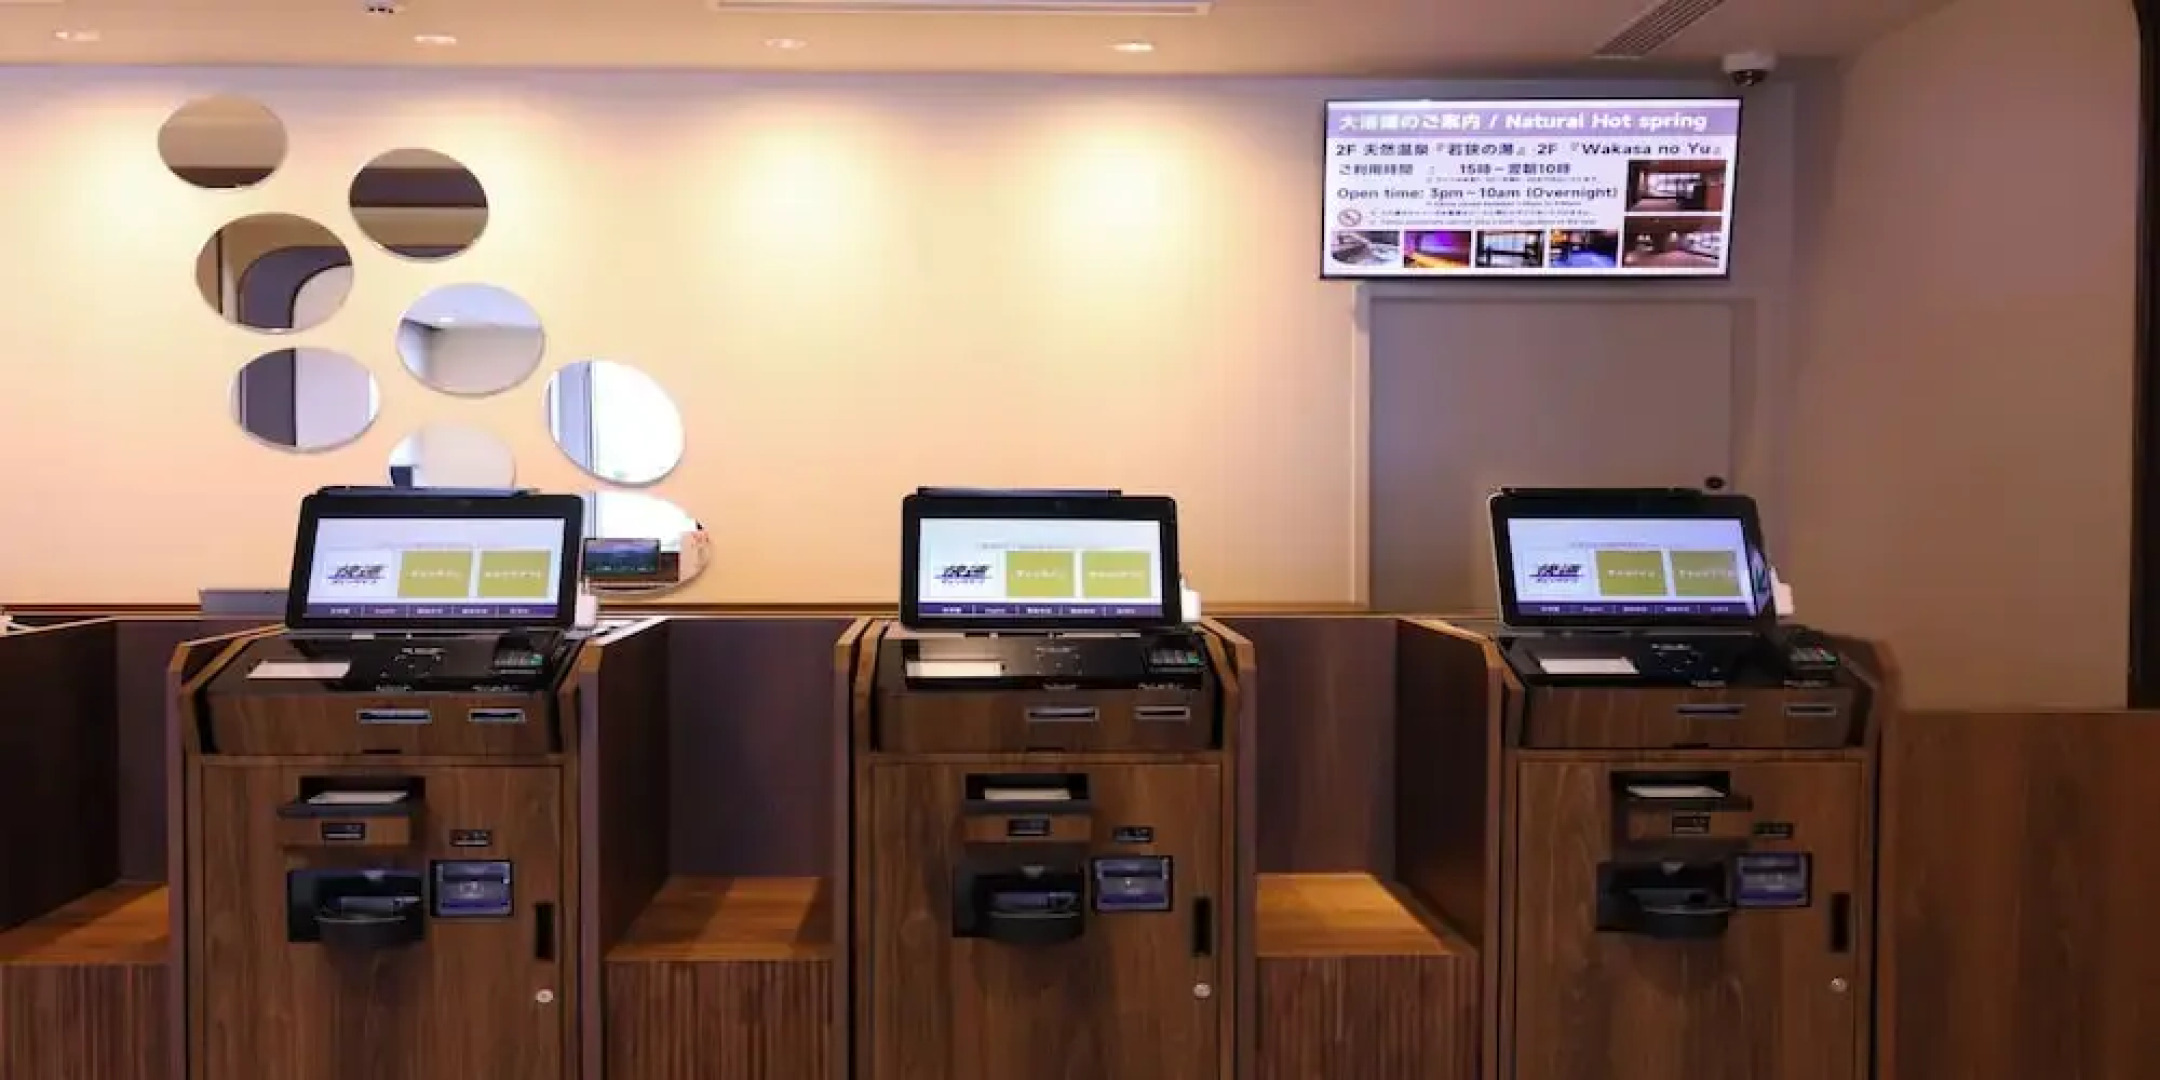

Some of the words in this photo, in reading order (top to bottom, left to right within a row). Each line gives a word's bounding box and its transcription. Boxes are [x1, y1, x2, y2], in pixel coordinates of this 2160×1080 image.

[1504, 112, 1584, 129] Natural
[1591, 113, 1632, 129] Hot
[1638, 112, 1708, 133] spring
[1336, 144, 1357, 156] 2F
[1537, 142, 1558, 155] 2F
[1658, 144, 1680, 155] no
[1336, 187, 1379, 200] Open
[1384, 187, 1425, 199] time:
[1526, 186, 1619, 201] (Overnight)
